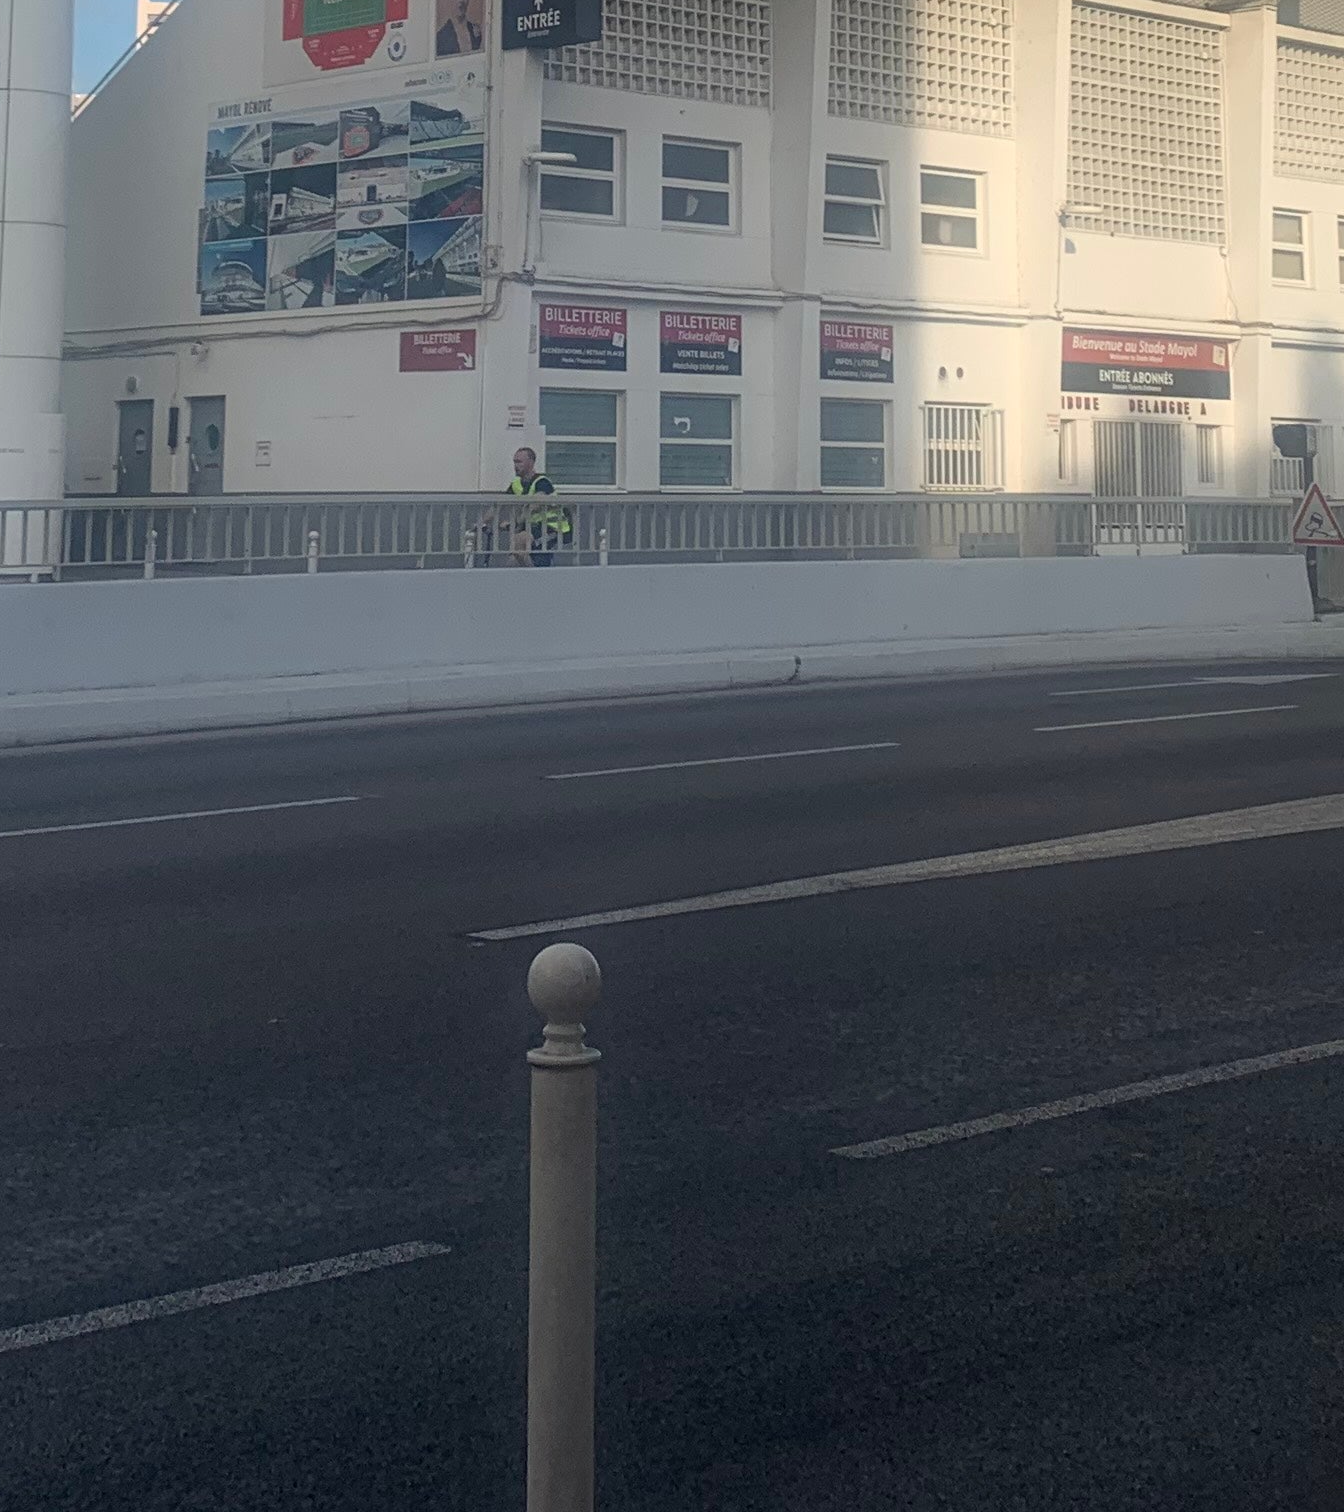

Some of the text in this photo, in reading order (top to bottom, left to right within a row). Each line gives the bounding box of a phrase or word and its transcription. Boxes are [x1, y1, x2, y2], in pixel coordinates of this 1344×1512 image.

[517, 7, 561, 32] ENTRÉE
[545, 307, 623, 326] BILLETTERIE
[664, 314, 737, 331] BILLETTERIE
[413, 333, 461, 345] BILLETTERIE
[558, 324, 611, 338] Tickets office
[824, 323, 890, 341] BILLETTERIE
[1072, 335, 1198, 359] Bienvenue au Stade Mayol
[1099, 368, 1175, 386] ENTRÉE ABONNÉS
[1061, 396, 1207, 416] IBUNE DELANGRE A
